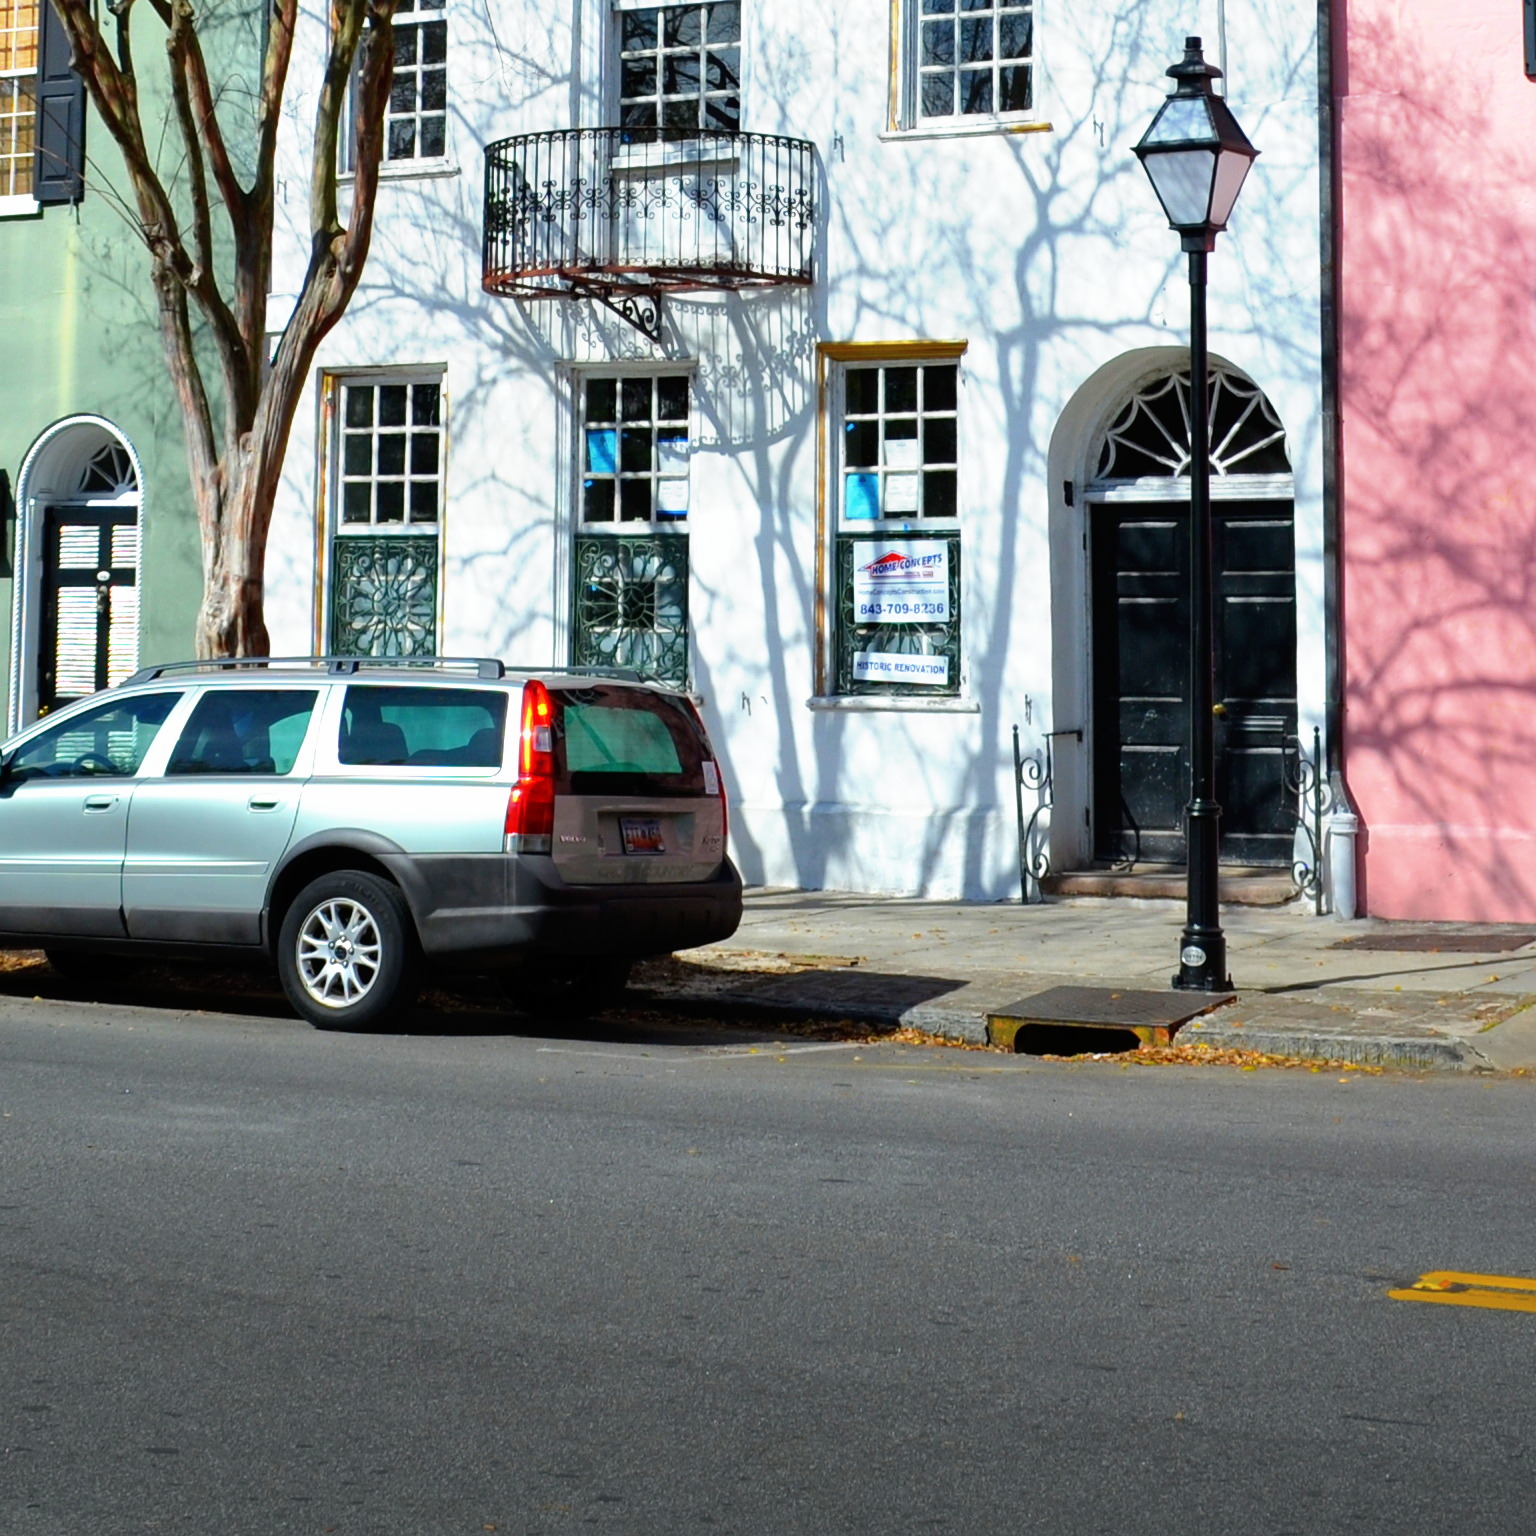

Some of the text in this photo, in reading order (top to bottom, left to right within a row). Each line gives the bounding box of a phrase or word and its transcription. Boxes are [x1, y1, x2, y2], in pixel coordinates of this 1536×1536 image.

[872, 562, 897, 575] HOME
[899, 553, 942, 570] CONCEPTS
[860, 603, 944, 615] 843-709-8236
[857, 661, 945, 675] HISTORIC RENOVATION
